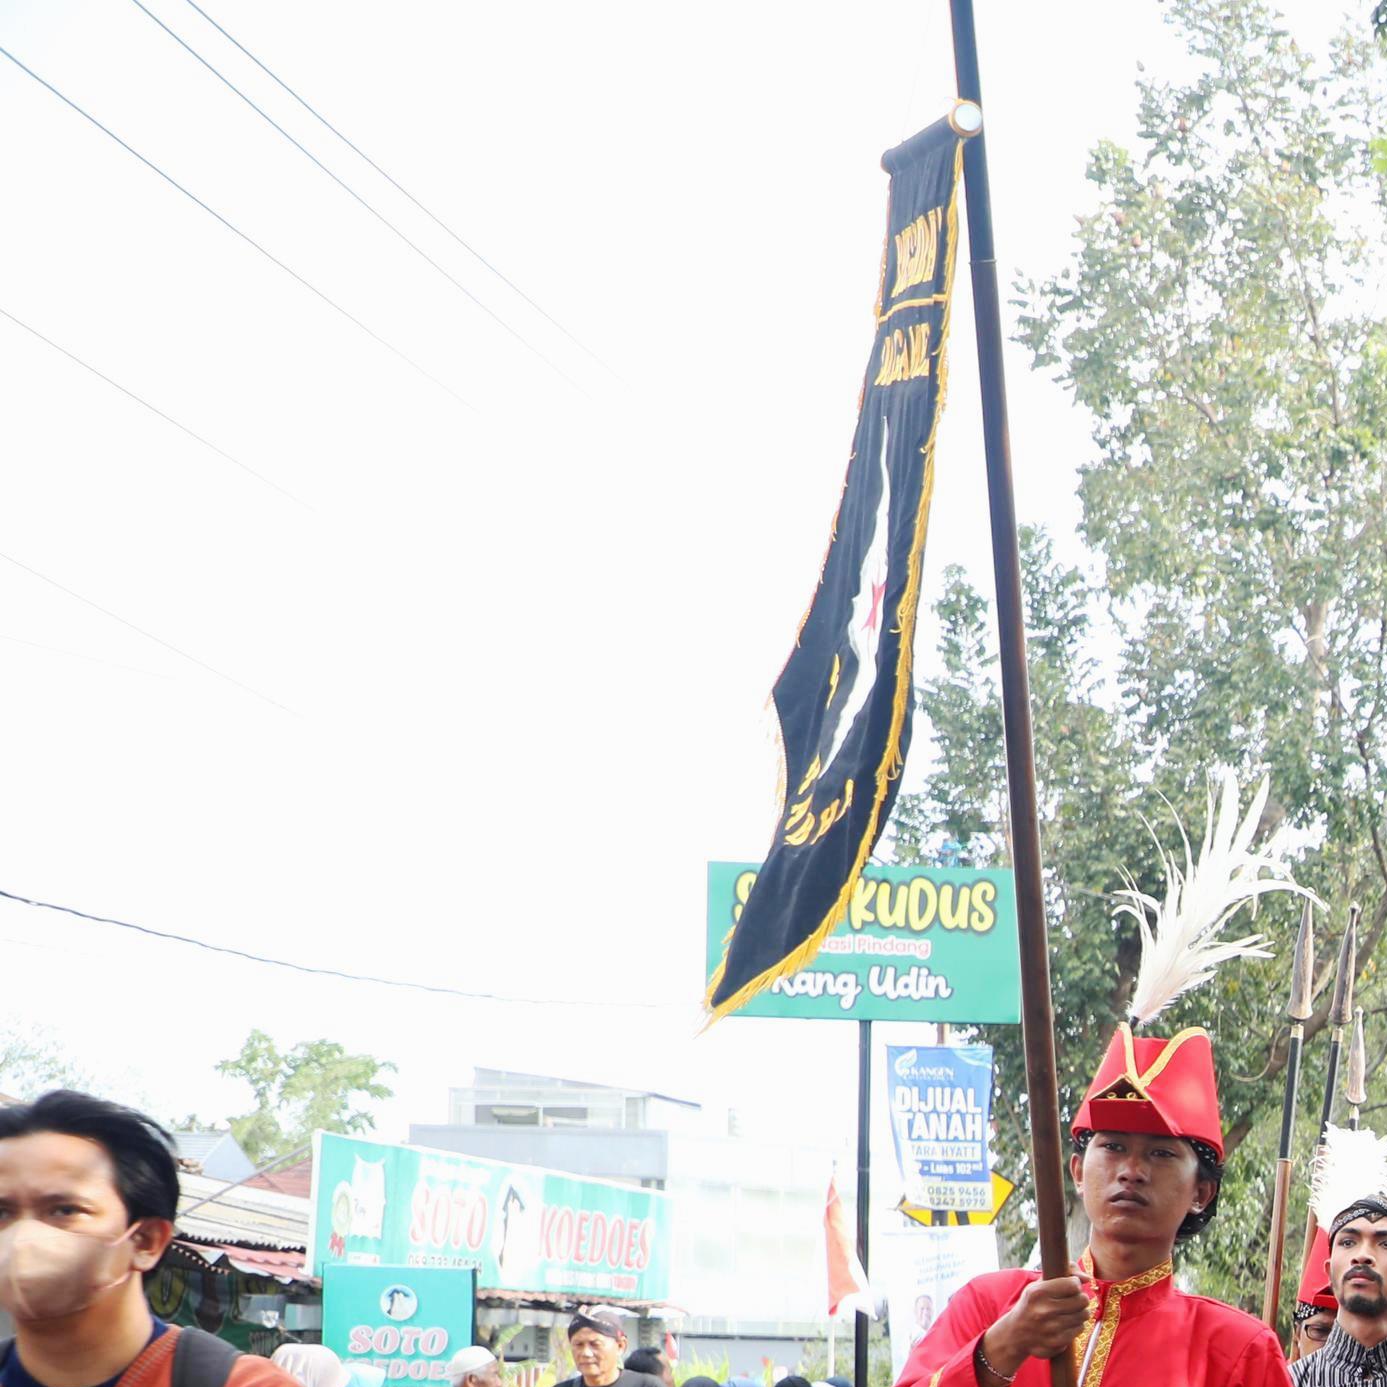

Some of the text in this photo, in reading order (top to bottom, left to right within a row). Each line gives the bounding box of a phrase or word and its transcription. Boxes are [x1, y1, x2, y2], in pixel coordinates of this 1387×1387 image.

[851, 876, 996, 932] KUDUS
[857, 937, 930, 956] Pindang
[868, 966, 952, 1000] Udin
[895, 1086, 982, 1114] DIJUAL
[897, 1112, 982, 1140] TANAH
[408, 1184, 489, 1251] SOTO
[538, 1205, 653, 1270] KOEDOES
[349, 1325, 449, 1356] SOTO
